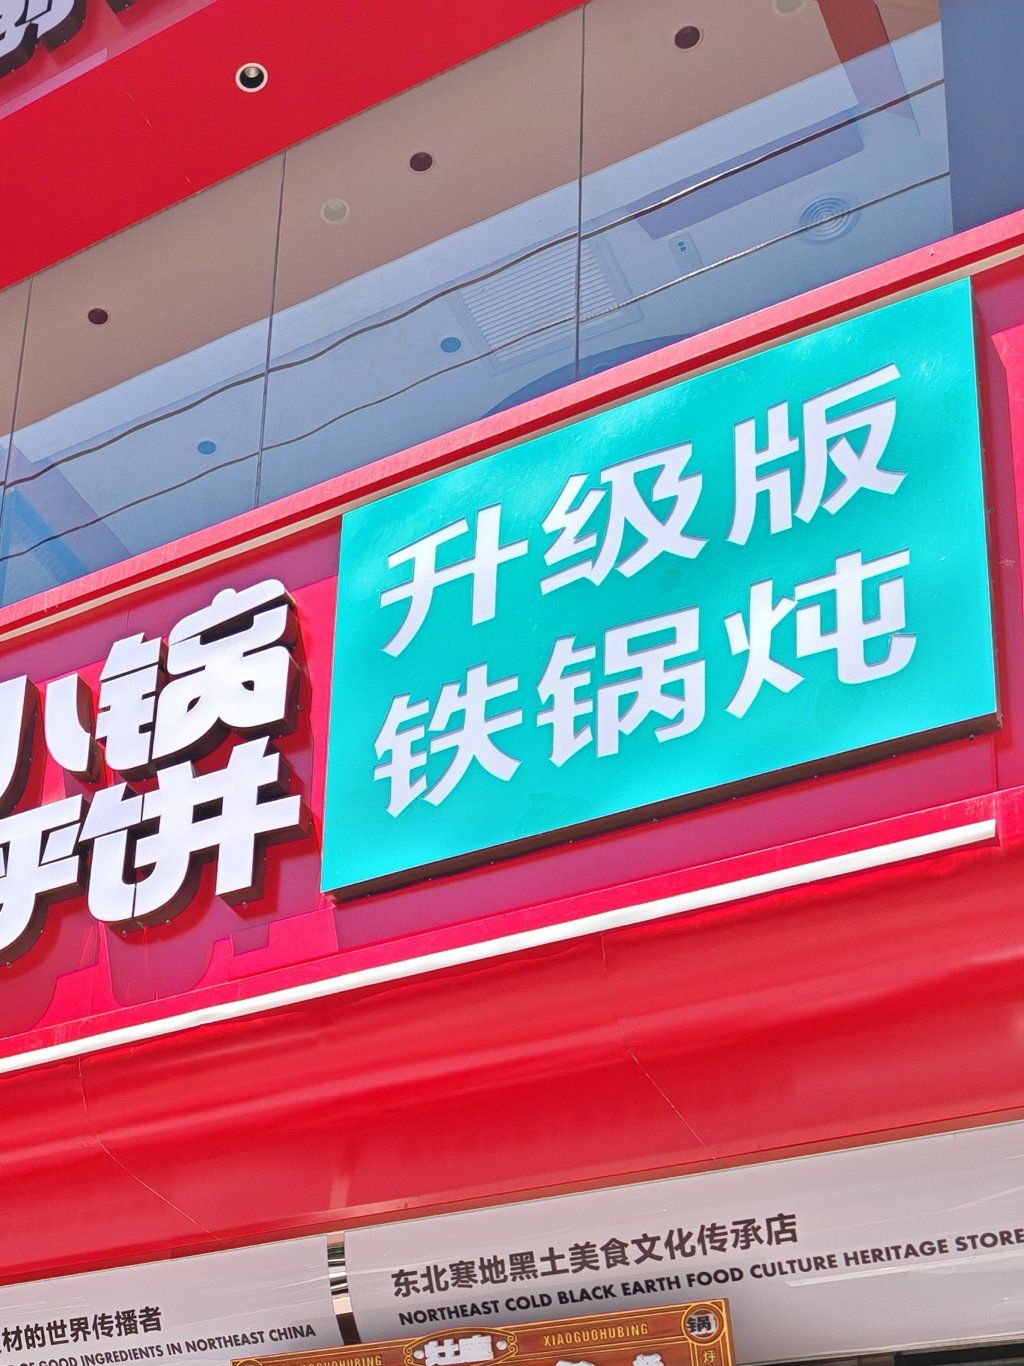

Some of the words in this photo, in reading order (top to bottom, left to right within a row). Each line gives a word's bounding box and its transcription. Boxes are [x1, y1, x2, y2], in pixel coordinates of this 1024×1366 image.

[380, 364, 907, 658] 升级版
[374, 549, 917, 817] 铁锅炖
[391, 1213, 798, 1298] 东北寒地黑土美食文化传承店
[399, 1300, 500, 1325] NORTHEAST
[505, 1293, 553, 1311] COLD
[558, 1284, 616, 1305] BLACK
[622, 1275, 682, 1297] EARTH
[687, 1267, 744, 1288] FOOD
[750, 1254, 839, 1279] CULTURE
[843, 1239, 949, 1267] HERITAGE
[955, 1228, 1024, 1252] STORE
[80, 1346, 164, 1366] INGREDIENTS
[166, 1343, 183, 1355] IN
[186, 1330, 265, 1353] NORTHEAST
[269, 1324, 316, 1341] CHINA
[543, 1323, 649, 1347] XIAOGUOHUBING
